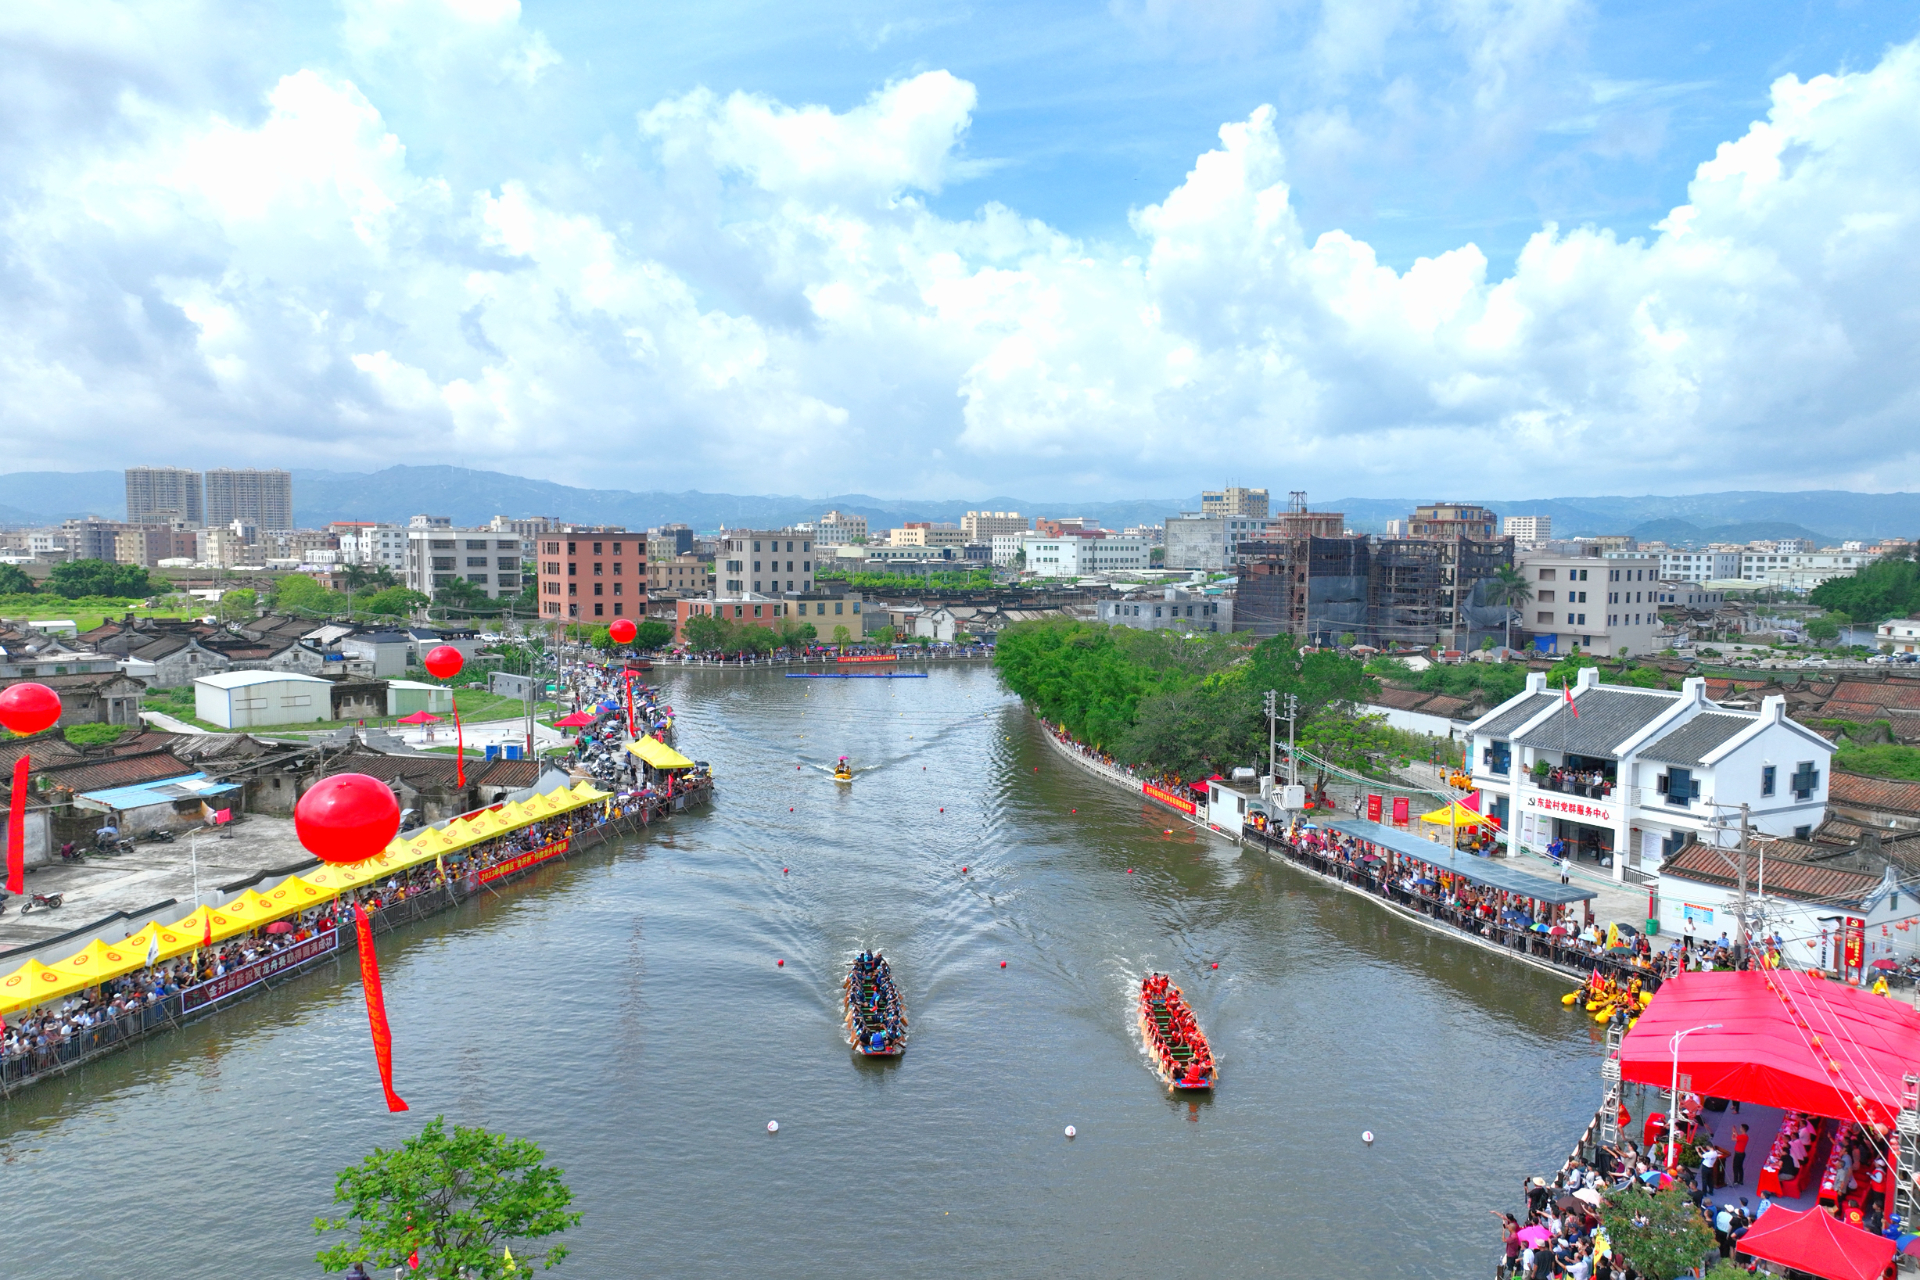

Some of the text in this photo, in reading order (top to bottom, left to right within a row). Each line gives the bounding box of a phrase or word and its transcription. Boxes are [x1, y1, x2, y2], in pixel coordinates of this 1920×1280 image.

[1536, 797, 1610, 821] 东盐村党群服务中心
